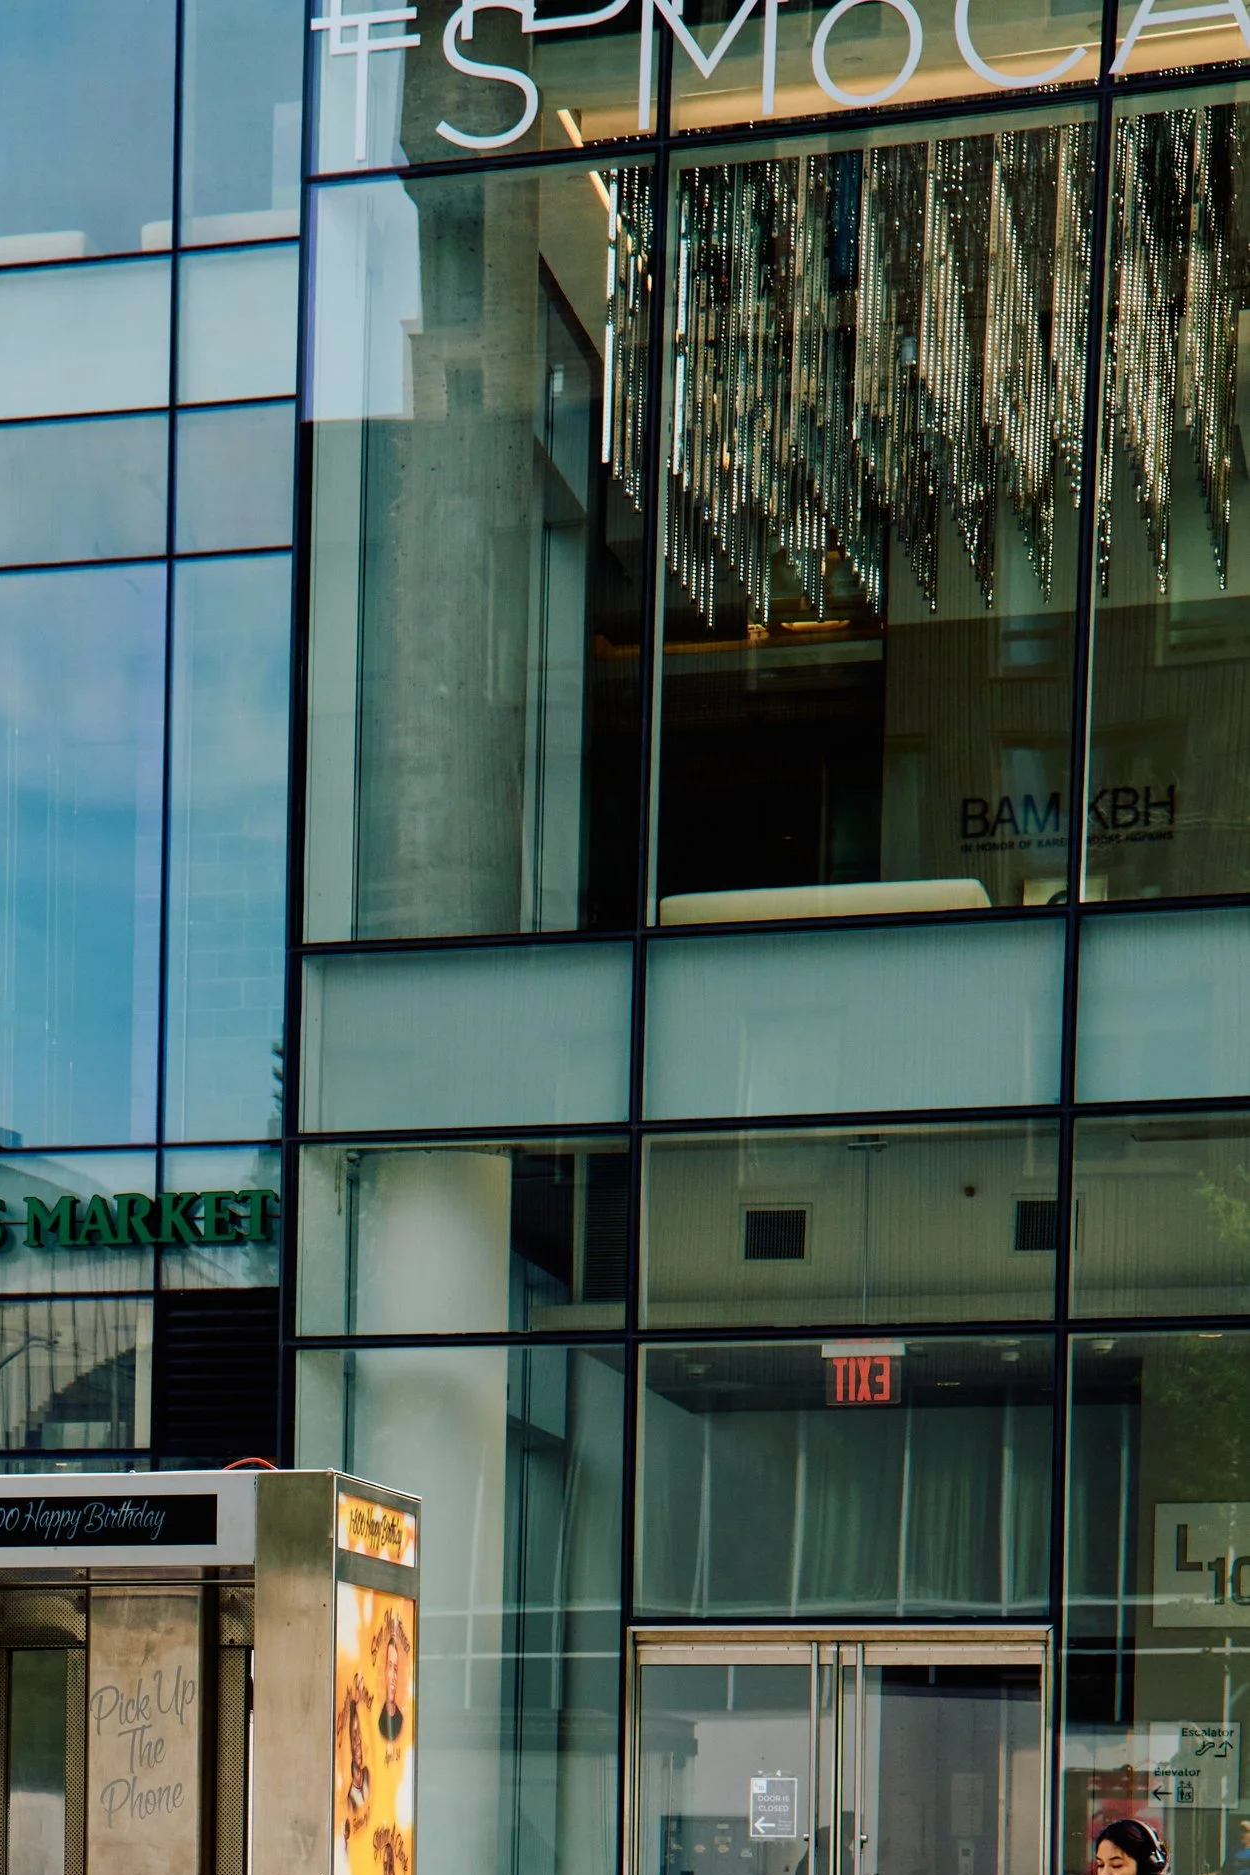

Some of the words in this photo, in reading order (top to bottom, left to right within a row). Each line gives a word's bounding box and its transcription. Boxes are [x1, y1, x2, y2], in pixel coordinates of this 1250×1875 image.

[961, 792, 1062, 839] BAM
[1037, 837, 1067, 848] KARE
[23, 1189, 279, 1248] MARKET
[22, 1500, 84, 1540] Happy
[84, 1500, 166, 1541] Birthday
[89, 1677, 152, 1737] Pick
[153, 1665, 196, 1725] Up
[118, 1724, 167, 1774] The
[1181, 1727, 1235, 1738] Escalator
[1154, 1767, 1201, 1777] Elevator
[100, 1776, 185, 1829] Phone
[758, 1804, 790, 1812] CLOSED
